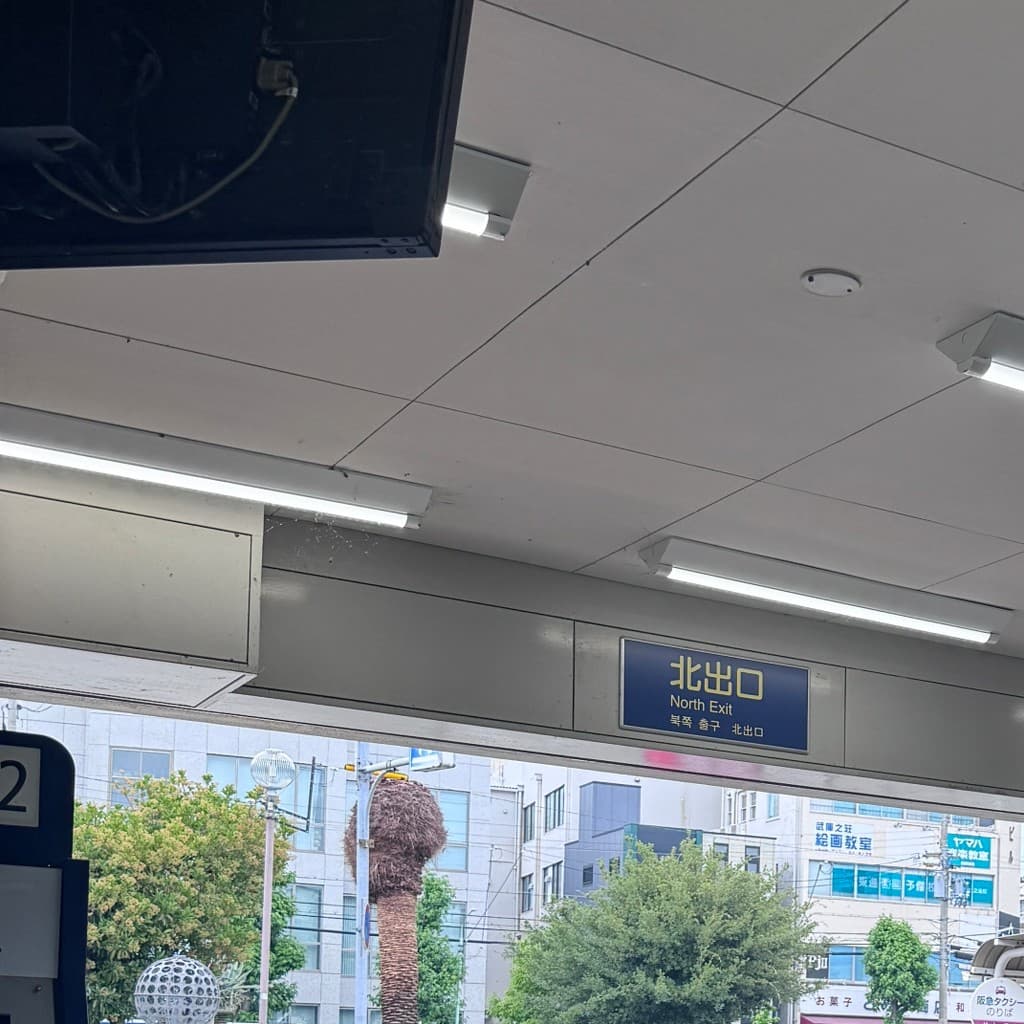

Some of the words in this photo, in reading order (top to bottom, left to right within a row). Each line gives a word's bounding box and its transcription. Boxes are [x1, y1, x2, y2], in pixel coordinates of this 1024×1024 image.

[670, 655, 764, 701] 北出口
[670, 694, 705, 712] North
[709, 700, 733, 716] Exit
[670, 713, 693, 729] 북쪽
[699, 717, 721, 732] 출구
[731, 722, 764, 737] 北出口
[0, 760, 27, 812] 2
[814, 832, 873, 851] 絵画教室
[952, 837, 984, 849] ヤマハ
[815, 996, 853, 1008] お菓子
[976, 995, 1024, 1007] 阪急タクシー
[986, 1007, 1015, 1017] のりば
